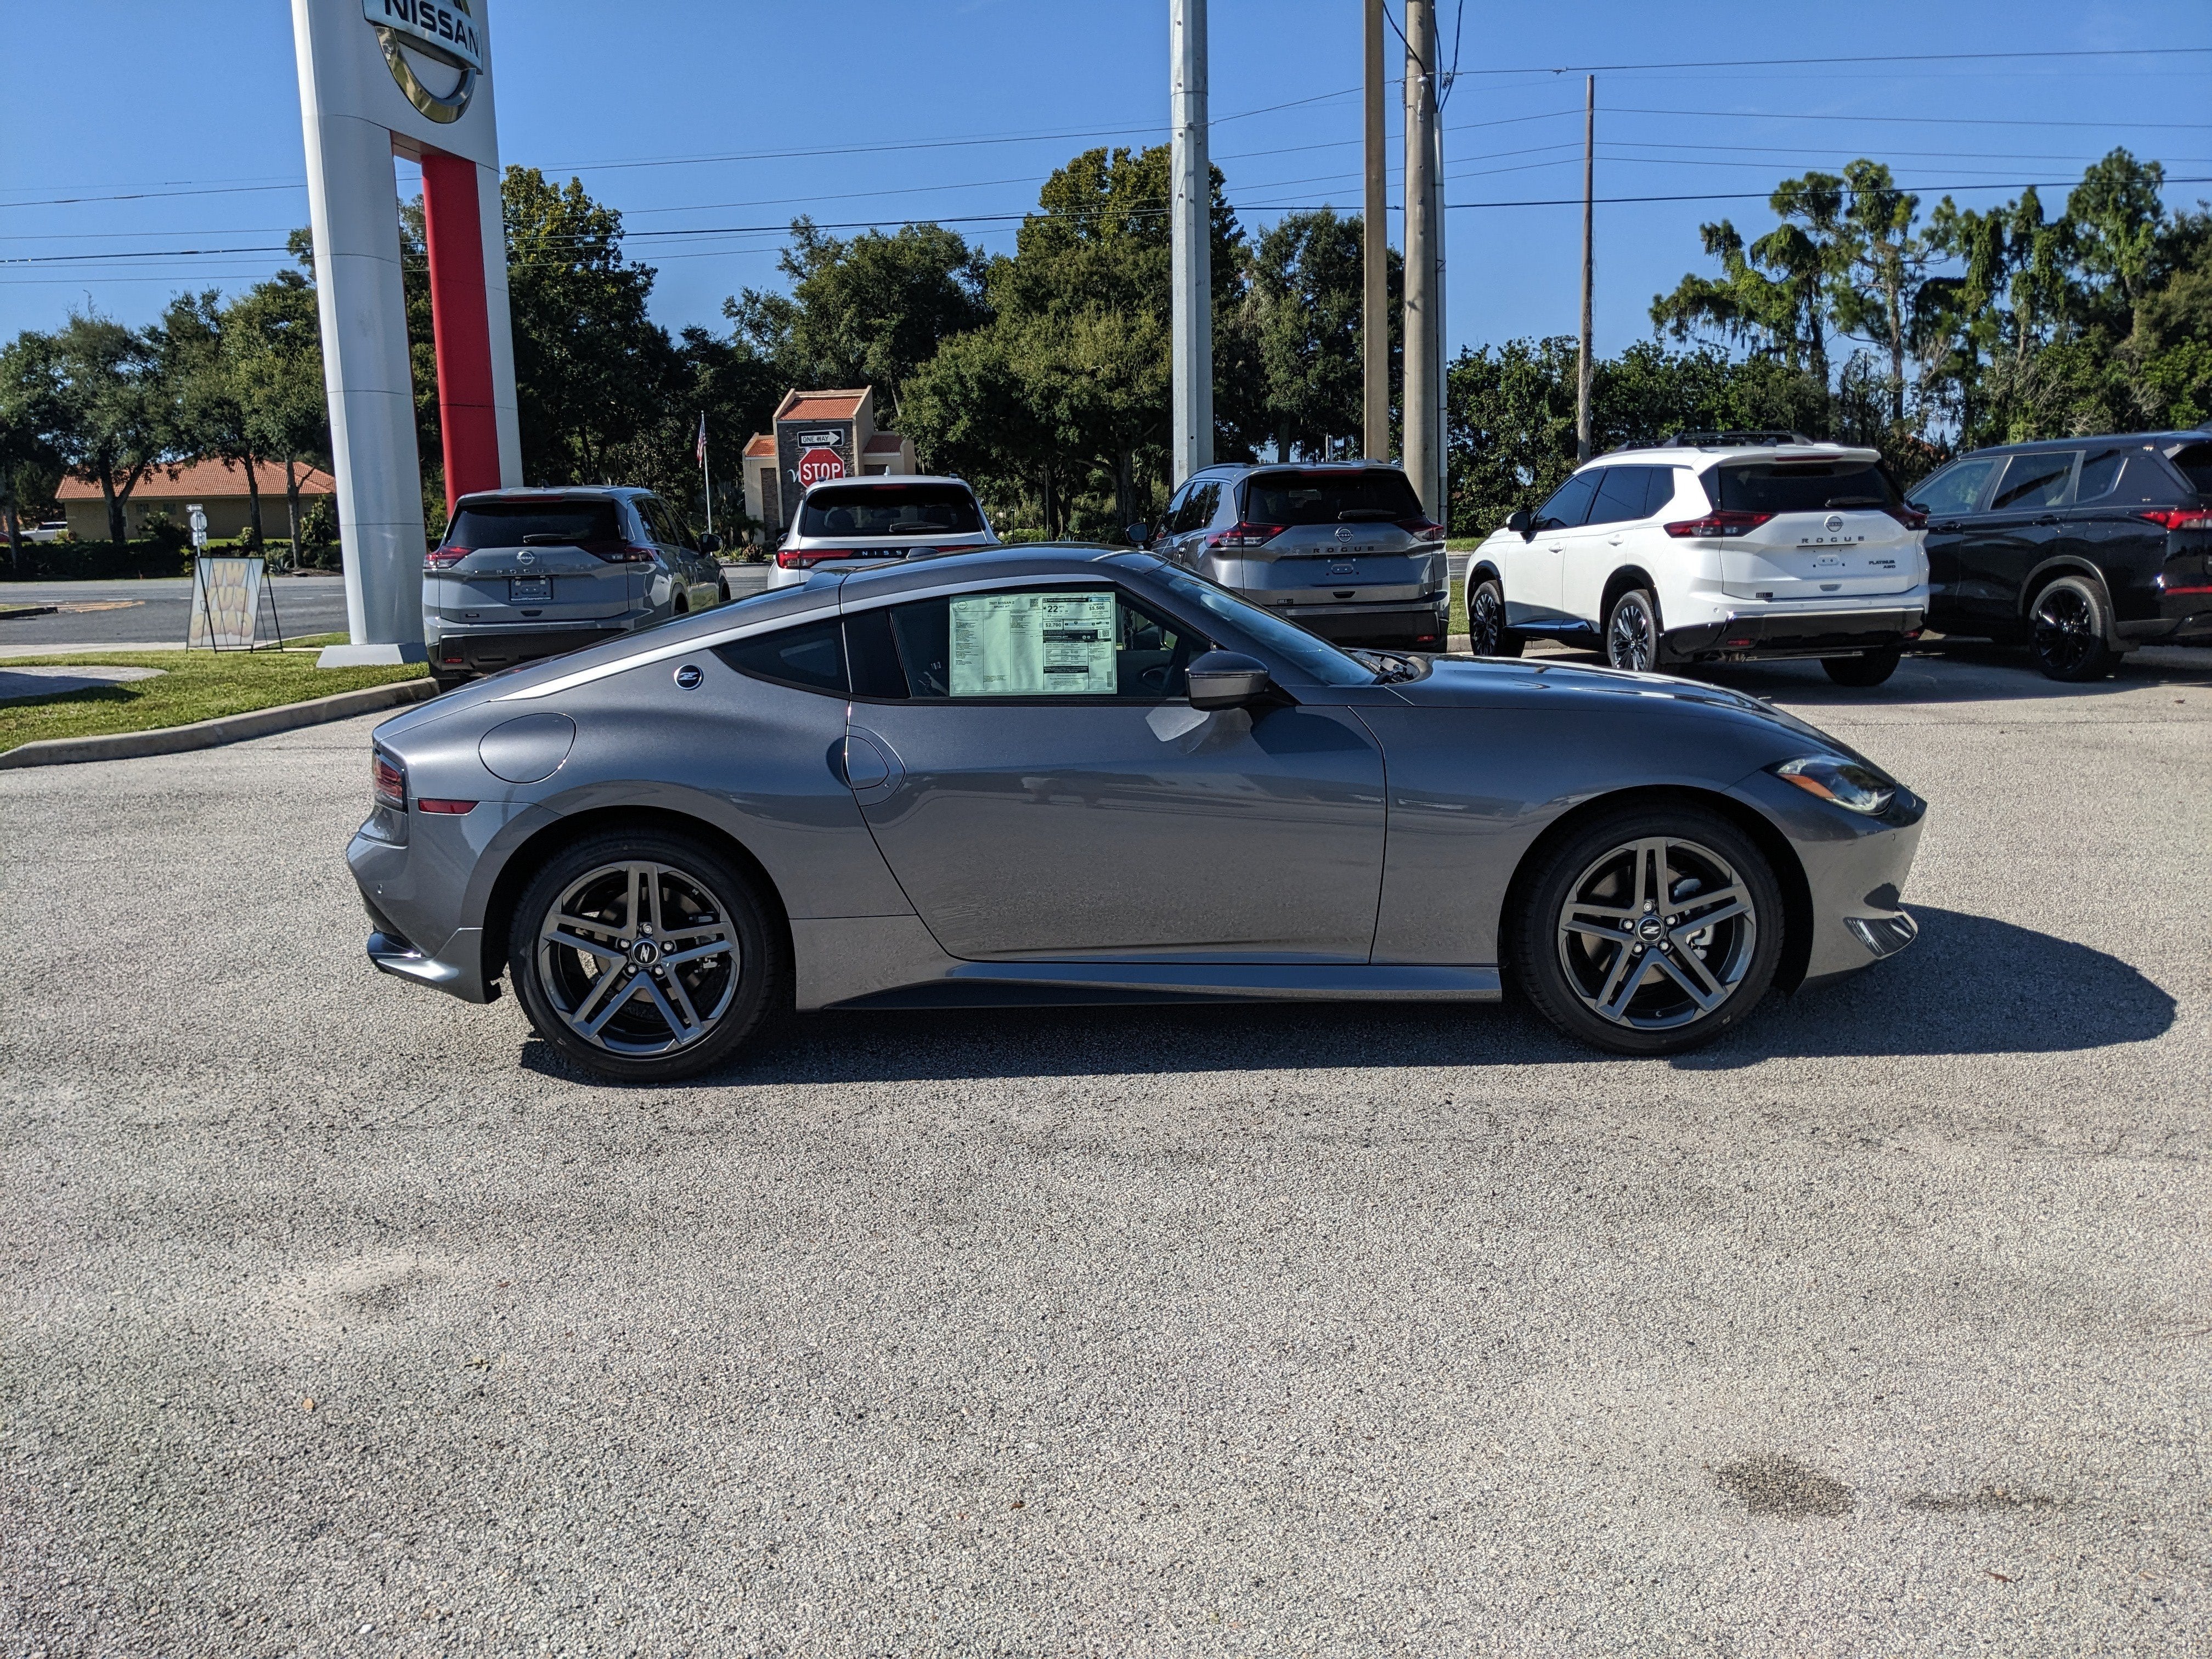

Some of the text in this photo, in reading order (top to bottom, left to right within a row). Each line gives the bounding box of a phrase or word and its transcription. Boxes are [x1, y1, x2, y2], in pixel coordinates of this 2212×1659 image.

[385, 0, 480, 60] NISSAN
[803, 462, 841, 481] STOP
[678, 672, 698, 680] Z
[1642, 926, 1660, 934] Z
